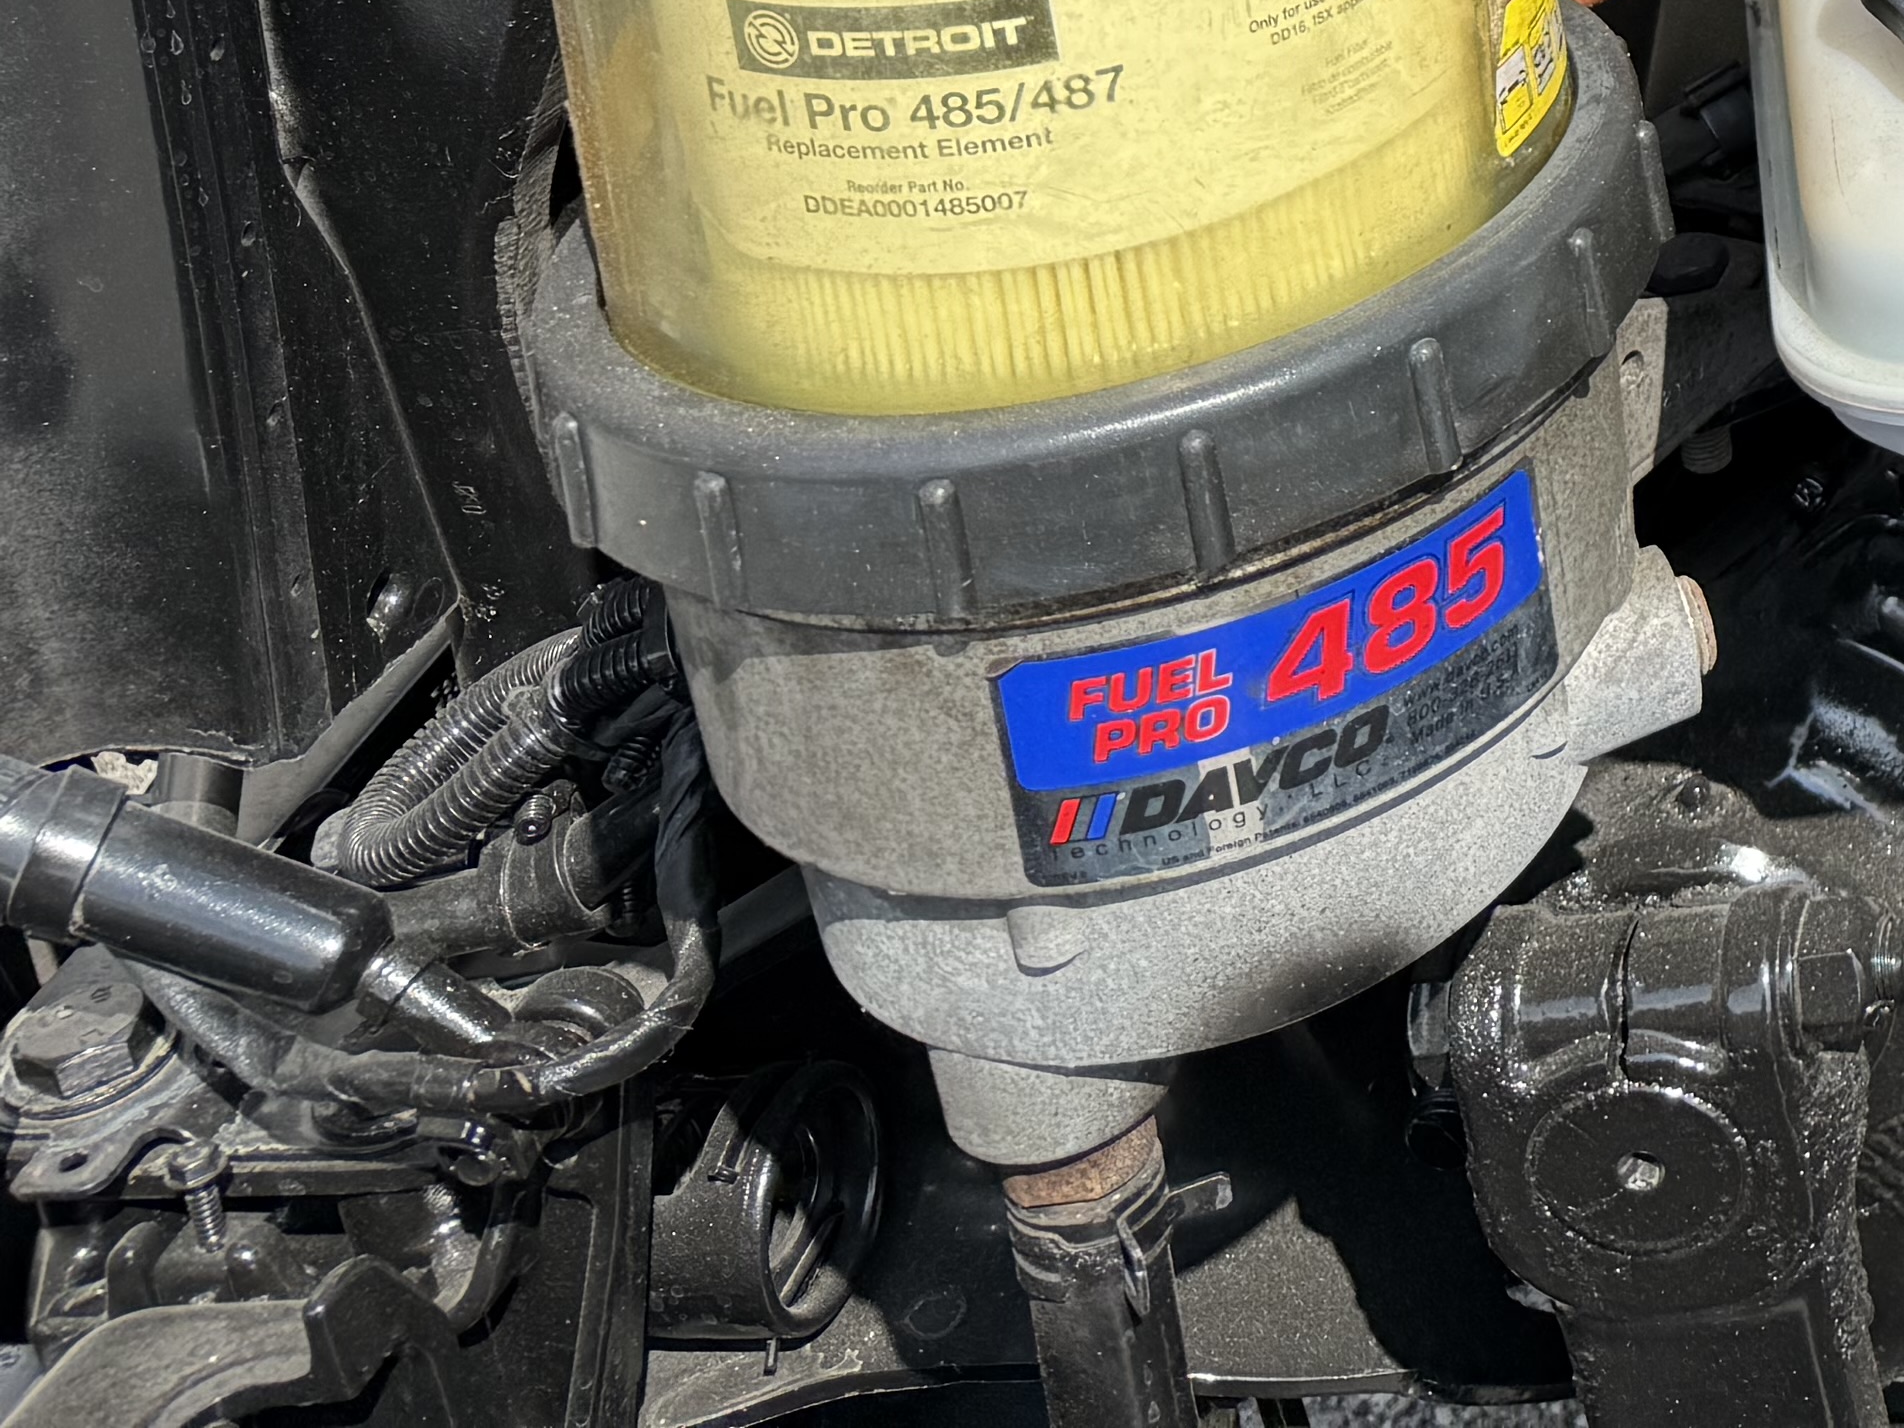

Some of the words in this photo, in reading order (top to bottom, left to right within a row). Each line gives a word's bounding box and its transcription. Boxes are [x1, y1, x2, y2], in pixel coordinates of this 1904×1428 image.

[807, 17, 1027, 58] DETROIT
[1250, 14, 1279, 35] Only
[1282, 3, 1302, 21] for
[706, 74, 790, 128] Fuel
[803, 91, 891, 133] Pro
[909, 63, 1126, 130] 485/487
[765, 132, 929, 161] Replacement
[937, 127, 1054, 159] Element
[803, 189, 1028, 219] DDEA0001485007
[847, 179, 903, 195] Reorder
[907, 179, 938, 194] Part
[942, 178, 971, 193] No.
[1265, 504, 1506, 704] 485
[1067, 648, 1233, 721] FUEL
[1092, 695, 1231, 763] PRO
[1119, 704, 1390, 835] DAVCO
